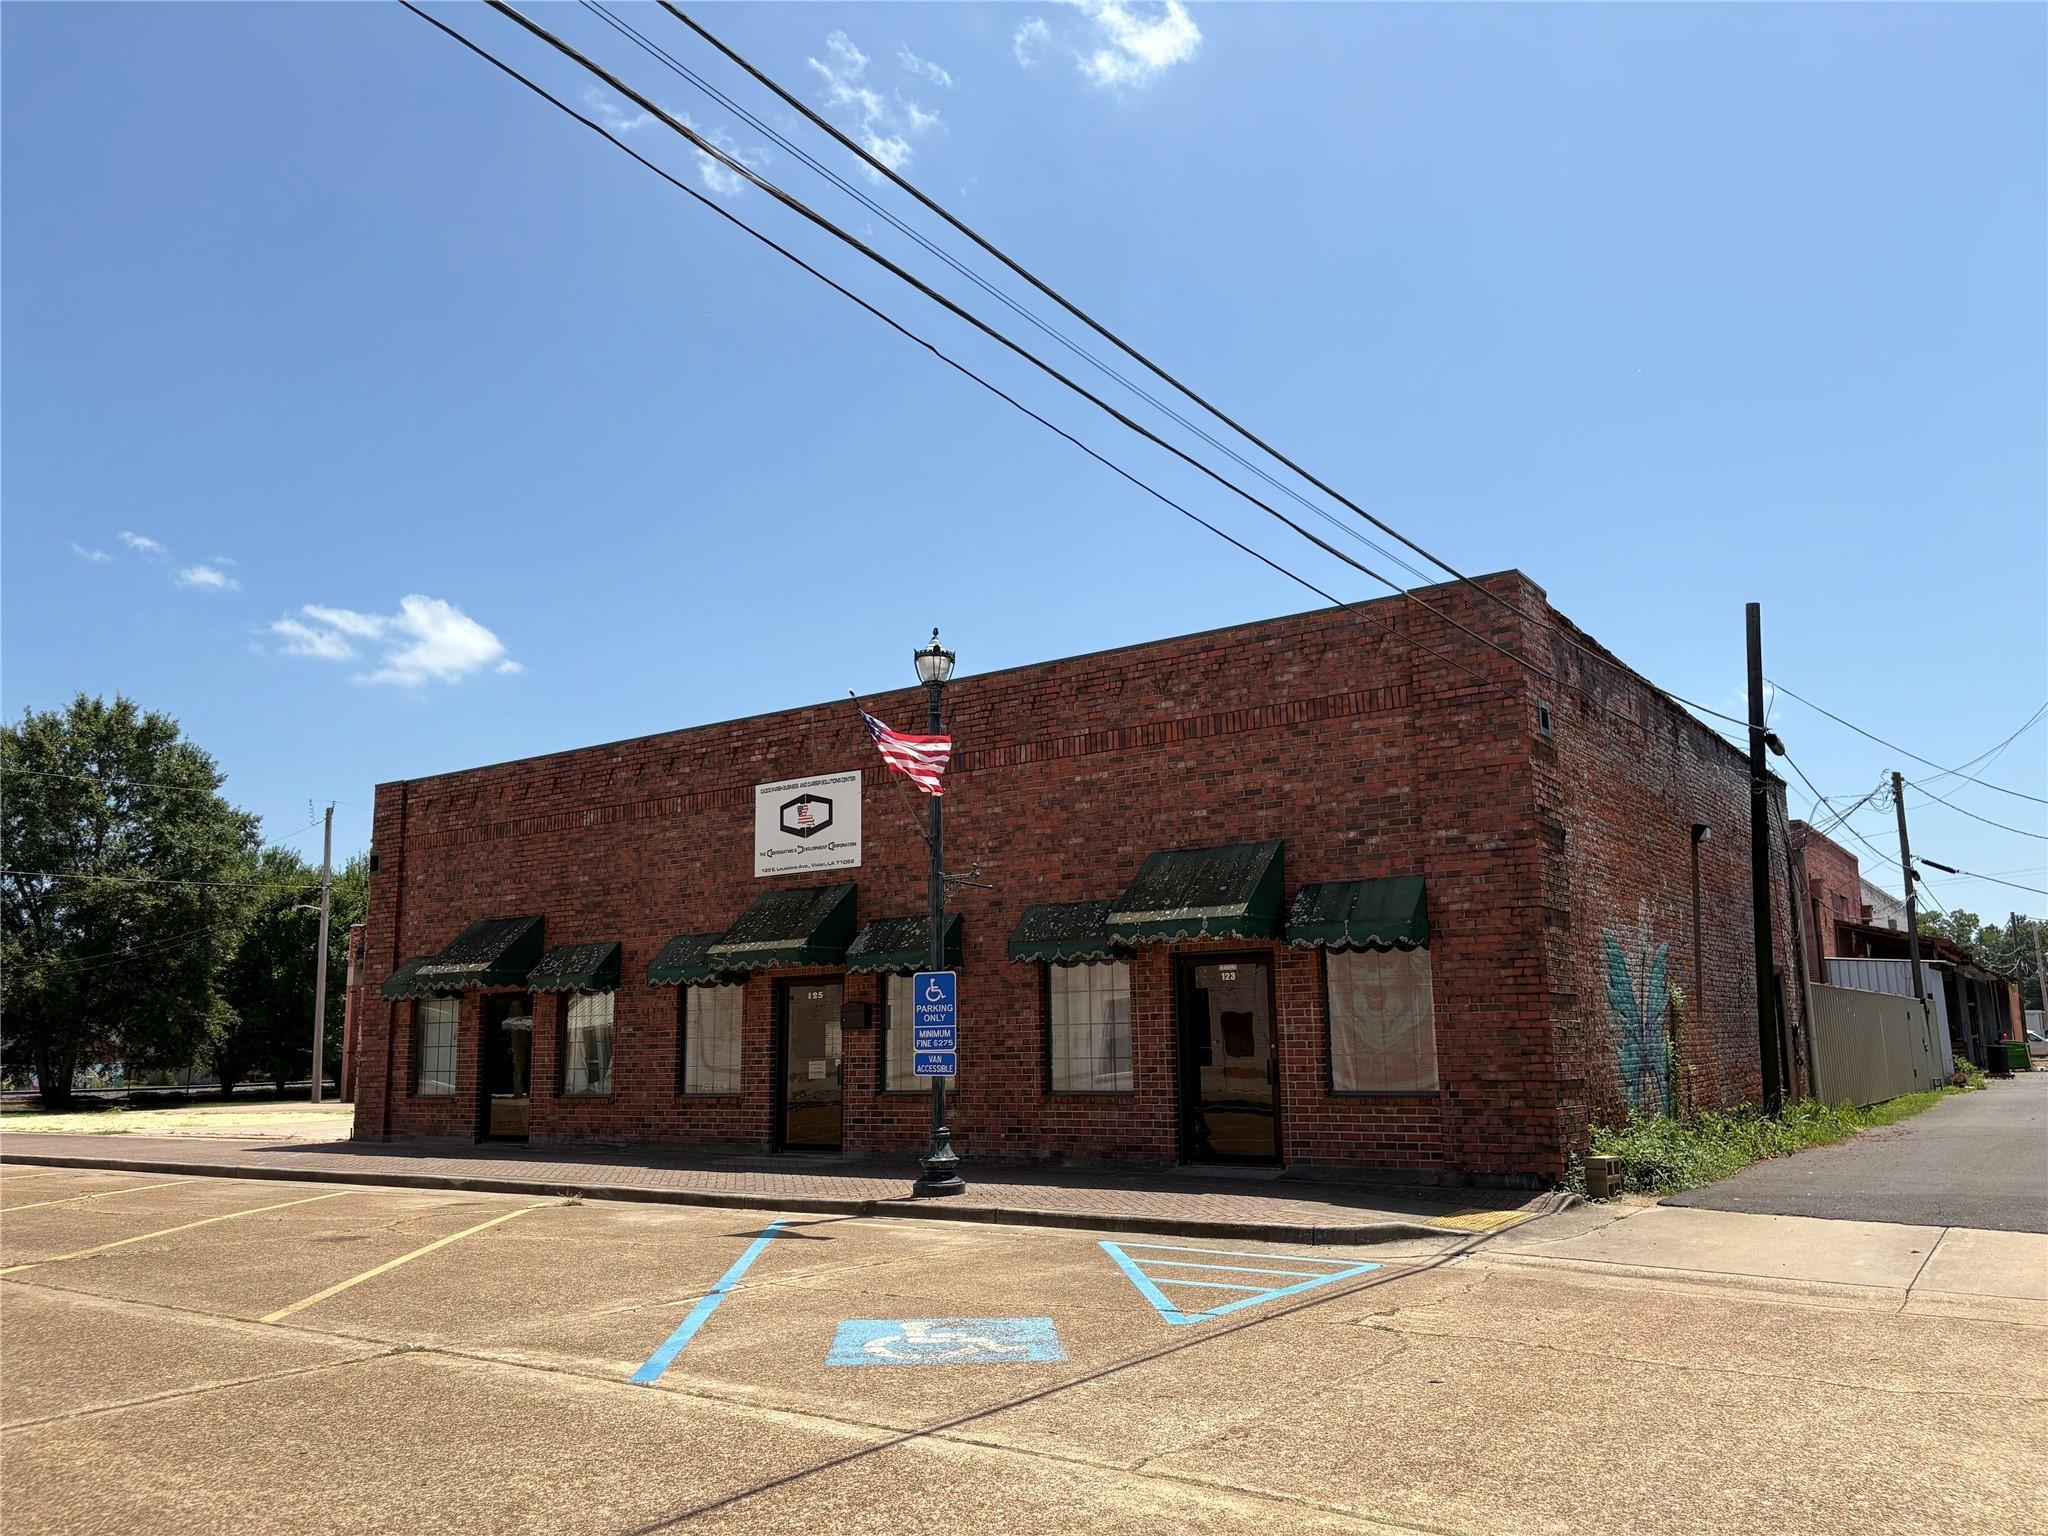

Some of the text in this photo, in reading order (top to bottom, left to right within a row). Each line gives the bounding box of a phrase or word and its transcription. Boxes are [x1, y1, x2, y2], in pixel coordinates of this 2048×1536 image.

[1221, 972, 1236, 981] 123
[807, 991, 823, 999] 125
[916, 1004, 954, 1012] PARKING
[923, 1014, 946, 1022] ONLY
[919, 1029, 951, 1038] MINIMUM
[916, 1039, 932, 1047] FINE
[928, 1055, 942, 1063] VAN
[917, 1064, 954, 1073] ACCESSIBLE
